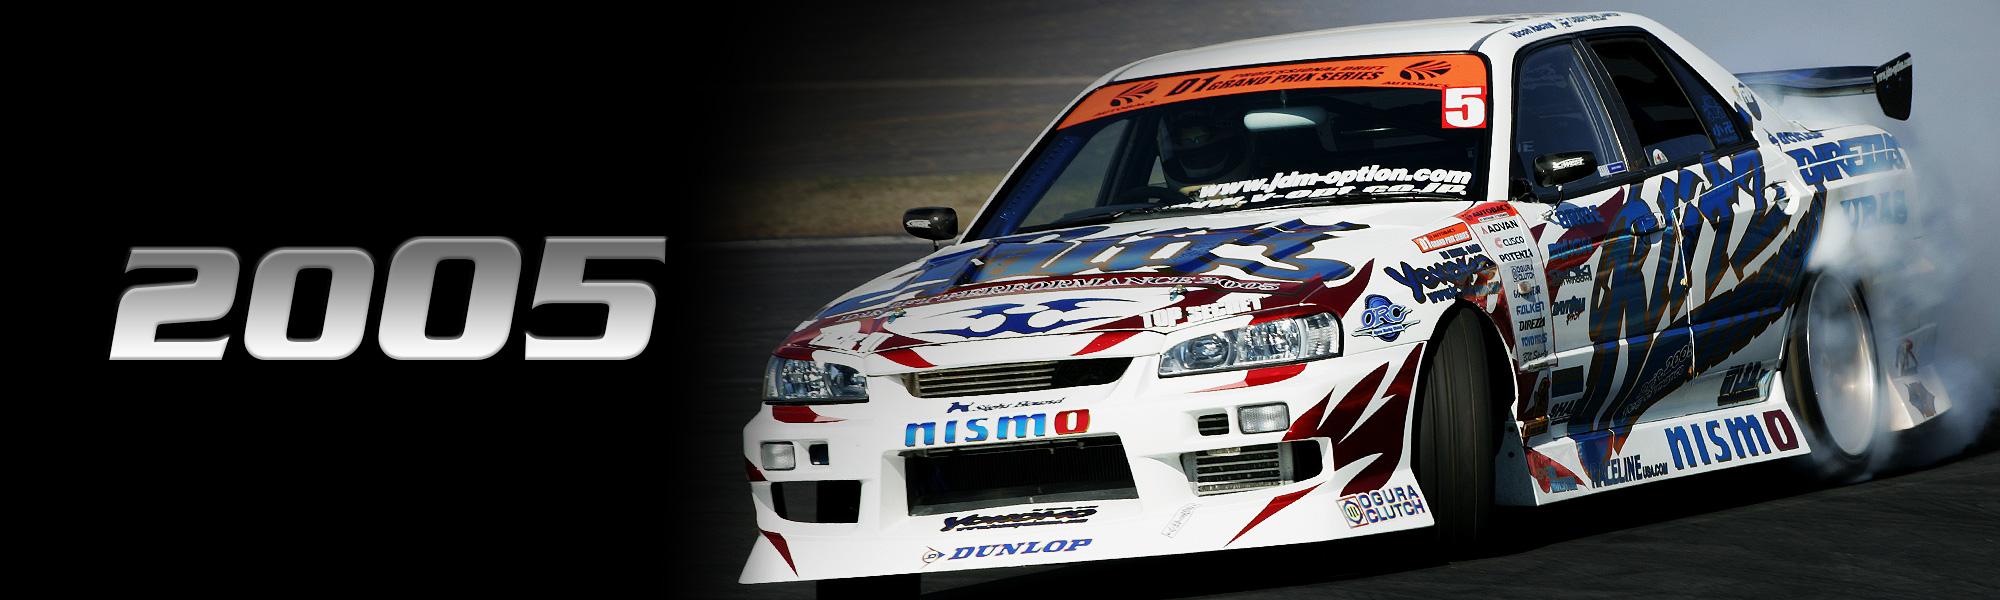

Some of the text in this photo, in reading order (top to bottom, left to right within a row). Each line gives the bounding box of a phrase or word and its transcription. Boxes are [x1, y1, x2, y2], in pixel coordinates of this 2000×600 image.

[1206, 70, 1383, 92] GRAND PRIX SERIES
[1445, 86, 1486, 129] 5
[1200, 164, 1471, 199] www.jdm-option.com
[1472, 204, 1511, 217] AUTOBACS
[1555, 204, 1605, 229] BRIDE
[1486, 219, 1519, 234] ADVAN
[1502, 236, 1525, 247] CUSCO
[1498, 248, 1534, 262] POTENZA
[1139, 297, 1268, 328] TOP SECRET
[1361, 303, 1413, 328] ORC
[1516, 301, 1545, 315] FALKEN
[1590, 454, 1642, 488] RACELINE
[1359, 484, 1420, 509] OGURA
[1366, 499, 1426, 523] CLUTCH
[947, 538, 1093, 561] DUNLOP
